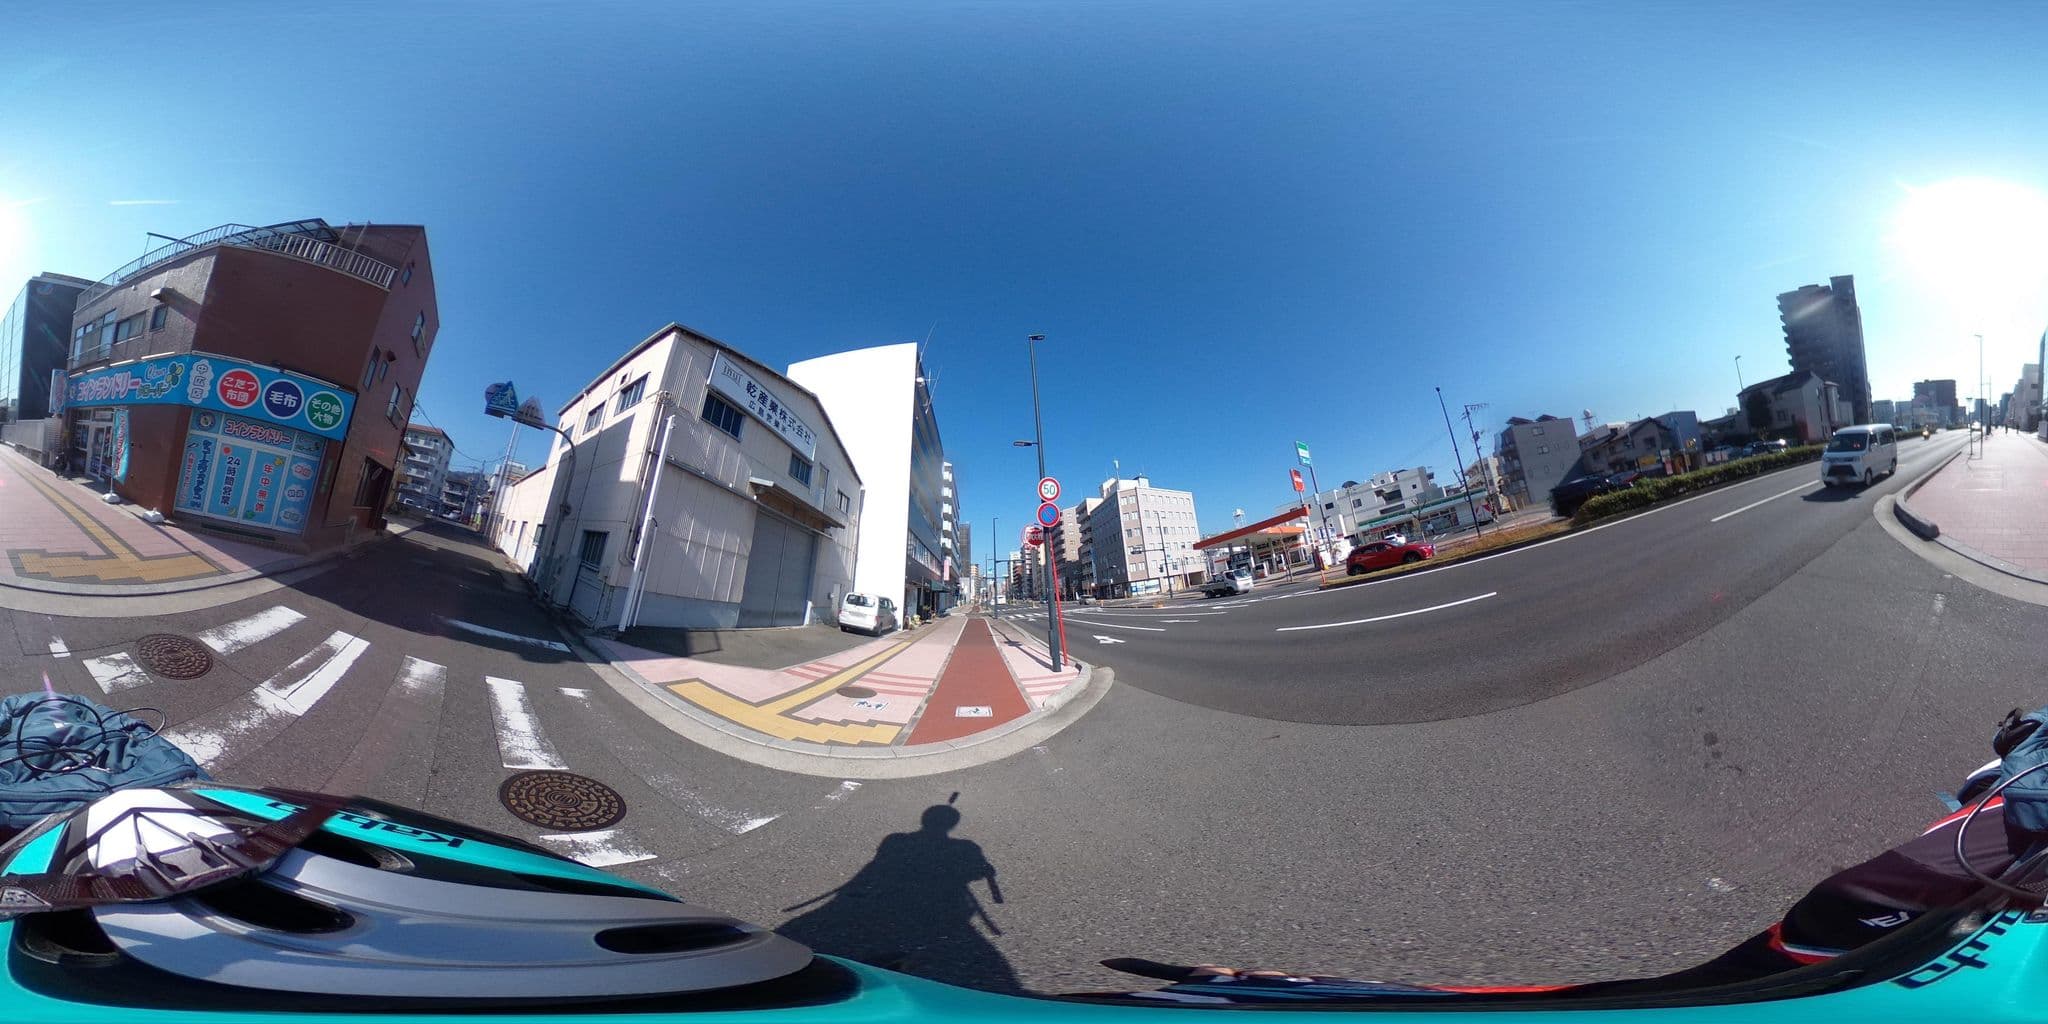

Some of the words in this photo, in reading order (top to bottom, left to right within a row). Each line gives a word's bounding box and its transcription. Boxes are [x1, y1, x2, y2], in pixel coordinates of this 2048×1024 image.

[78, 371, 141, 401] コインランドリー
[222, 377, 257, 391] こたつ
[226, 389, 249, 403] 布団
[269, 390, 298, 407] 毛布
[311, 398, 341, 416] その他
[746, 381, 811, 445] 乾産業株式会社
[313, 411, 333, 425] 大物
[224, 419, 292, 444] コインランドリー
[1043, 484, 1056, 495] 50
